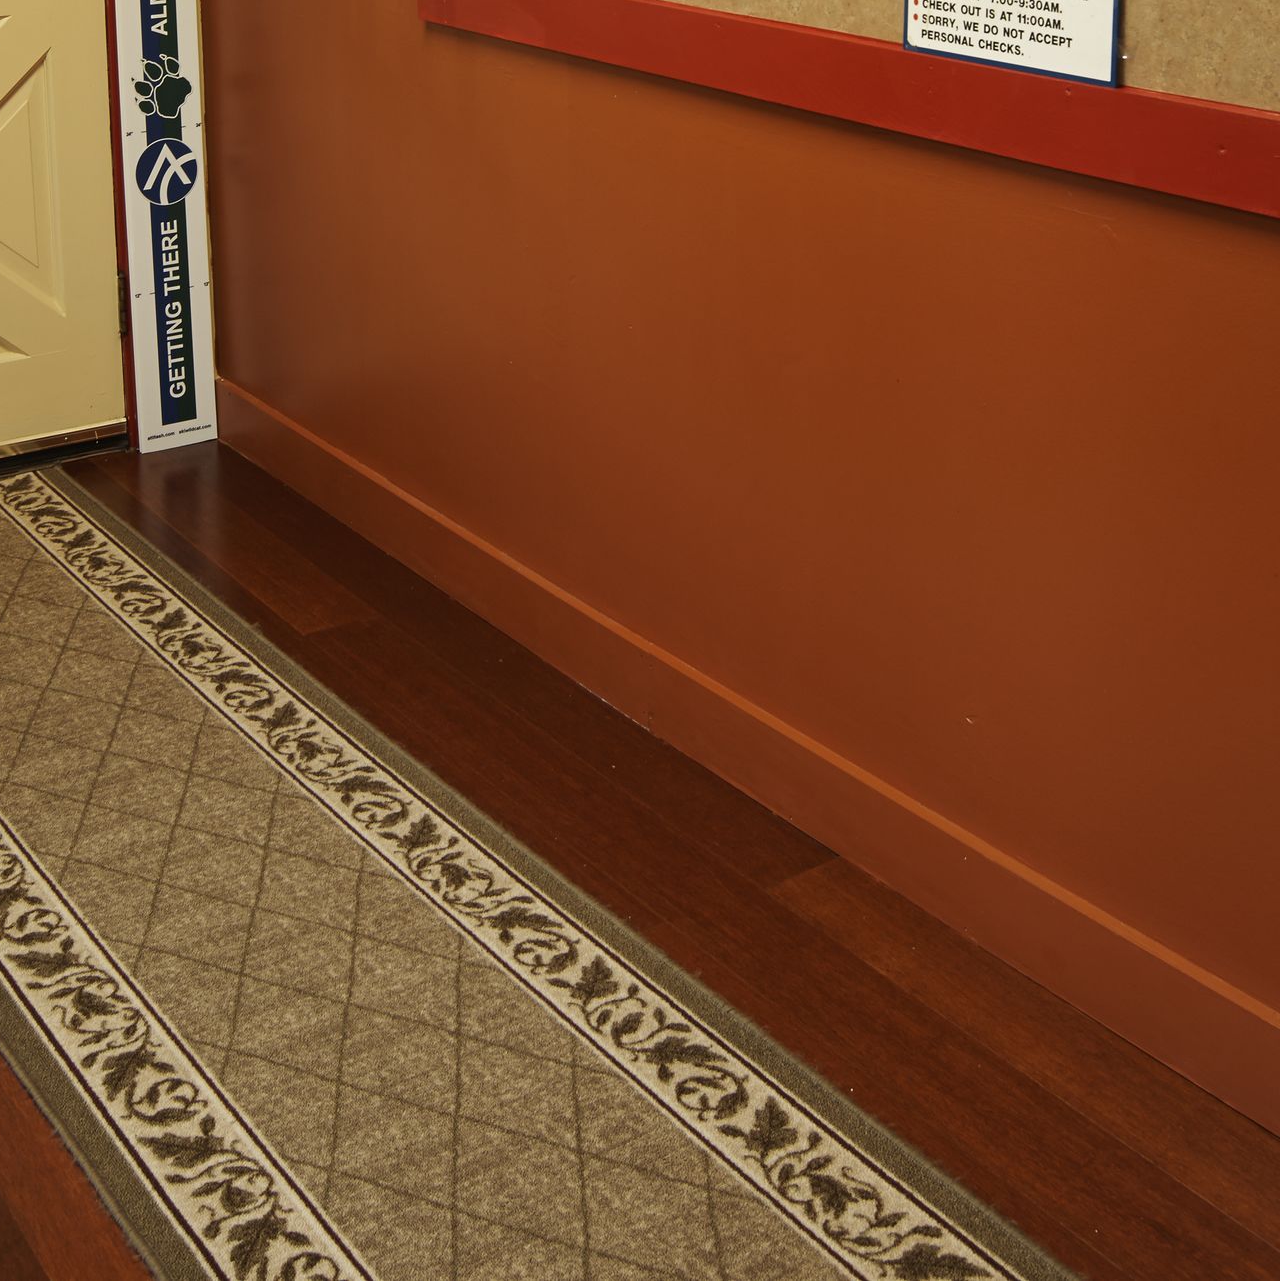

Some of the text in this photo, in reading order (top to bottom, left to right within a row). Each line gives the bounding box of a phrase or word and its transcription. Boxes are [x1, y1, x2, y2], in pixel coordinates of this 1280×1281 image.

[922, 0, 1064, 30] CHECK OUT IS AT 11:00AM.
[922, 14, 1073, 48] SORRY, WE DO NOT ACCEPT
[921, 29, 1024, 56] PERSONAL CHECKS.
[160, 219, 187, 399] GETTING THERE
